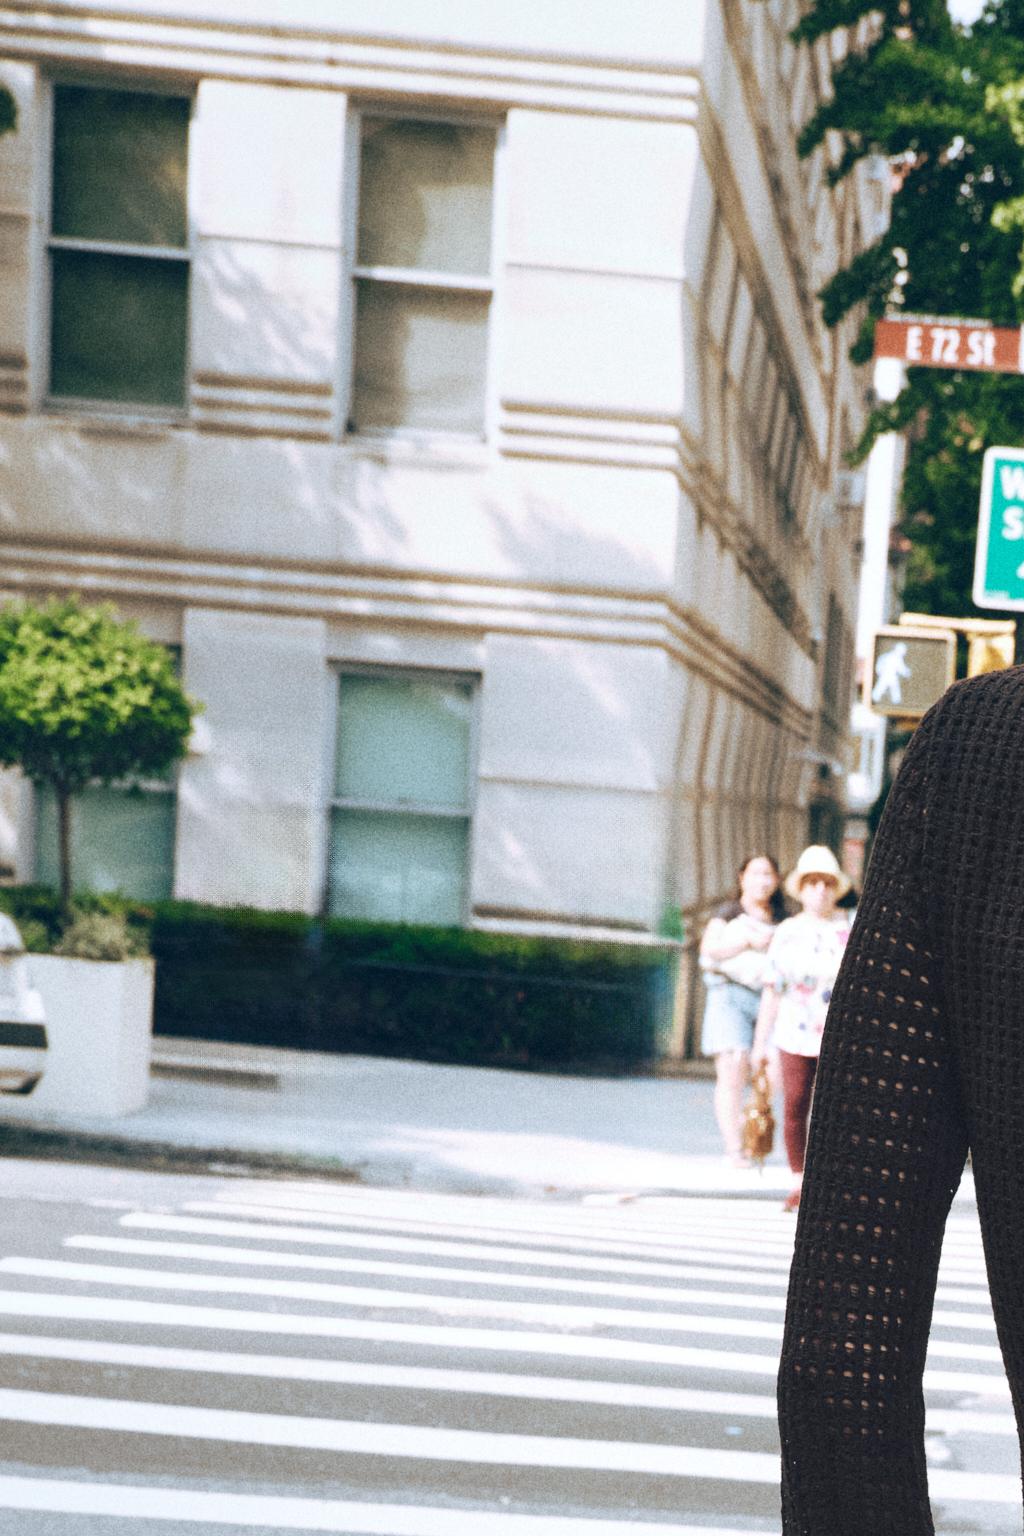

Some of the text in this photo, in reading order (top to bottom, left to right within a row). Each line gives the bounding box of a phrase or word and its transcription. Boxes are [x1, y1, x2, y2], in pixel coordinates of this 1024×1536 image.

[906, 326, 996, 365] E 72 St
